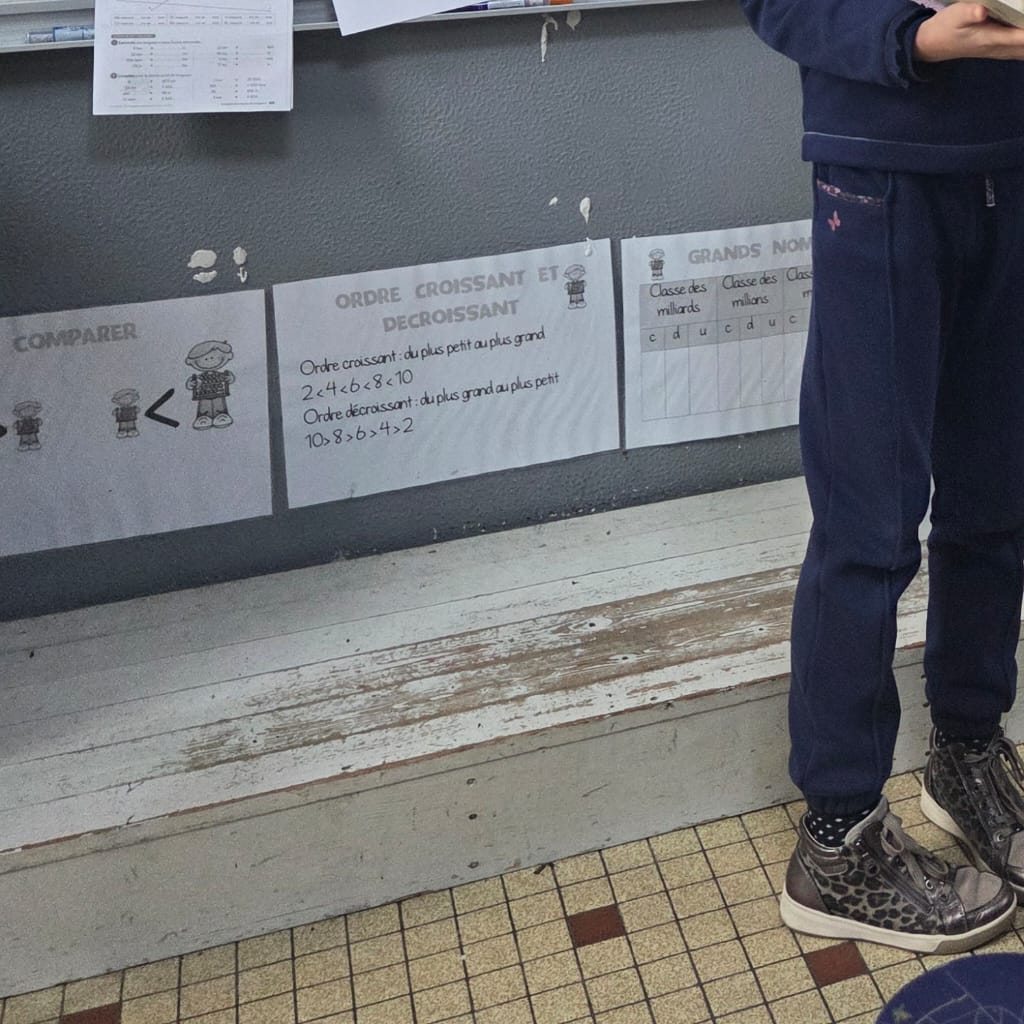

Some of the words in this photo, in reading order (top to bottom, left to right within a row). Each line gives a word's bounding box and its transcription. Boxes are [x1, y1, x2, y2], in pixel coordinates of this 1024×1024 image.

[687, 242, 762, 265] GRANDS
[334, 287, 401, 310] ORDRE
[414, 269, 526, 299] CROISSANT
[537, 265, 560, 283] ET
[650, 282, 686, 299] Classe
[687, 280, 708, 295] des
[721, 274, 758, 290] Classe
[758, 272, 778, 285] des
[656, 299, 701, 318] milliards
[731, 292, 769, 309] millions
[382, 299, 520, 333] DECROISSANT
[13, 322, 138, 353] COMPARER
[299, 357, 341, 377] Ordre
[341, 351, 398, 370] croissant
[403, 345, 419, 361] du
[420, 342, 445, 361] plus
[446, 338, 473, 357] petit
[473, 339, 489, 349] au
[488, 331, 513, 352] plus
[513, 325, 547, 347] grand
[303, 406, 344, 425] Ordre
[345, 396, 414, 419] décroissant
[419, 391, 435, 406] du
[435, 386, 460, 407] plus
[461, 380, 495, 404] grand
[495, 383, 510, 394] au
[509, 374, 534, 395] plus
[534, 371, 560, 392] petit
